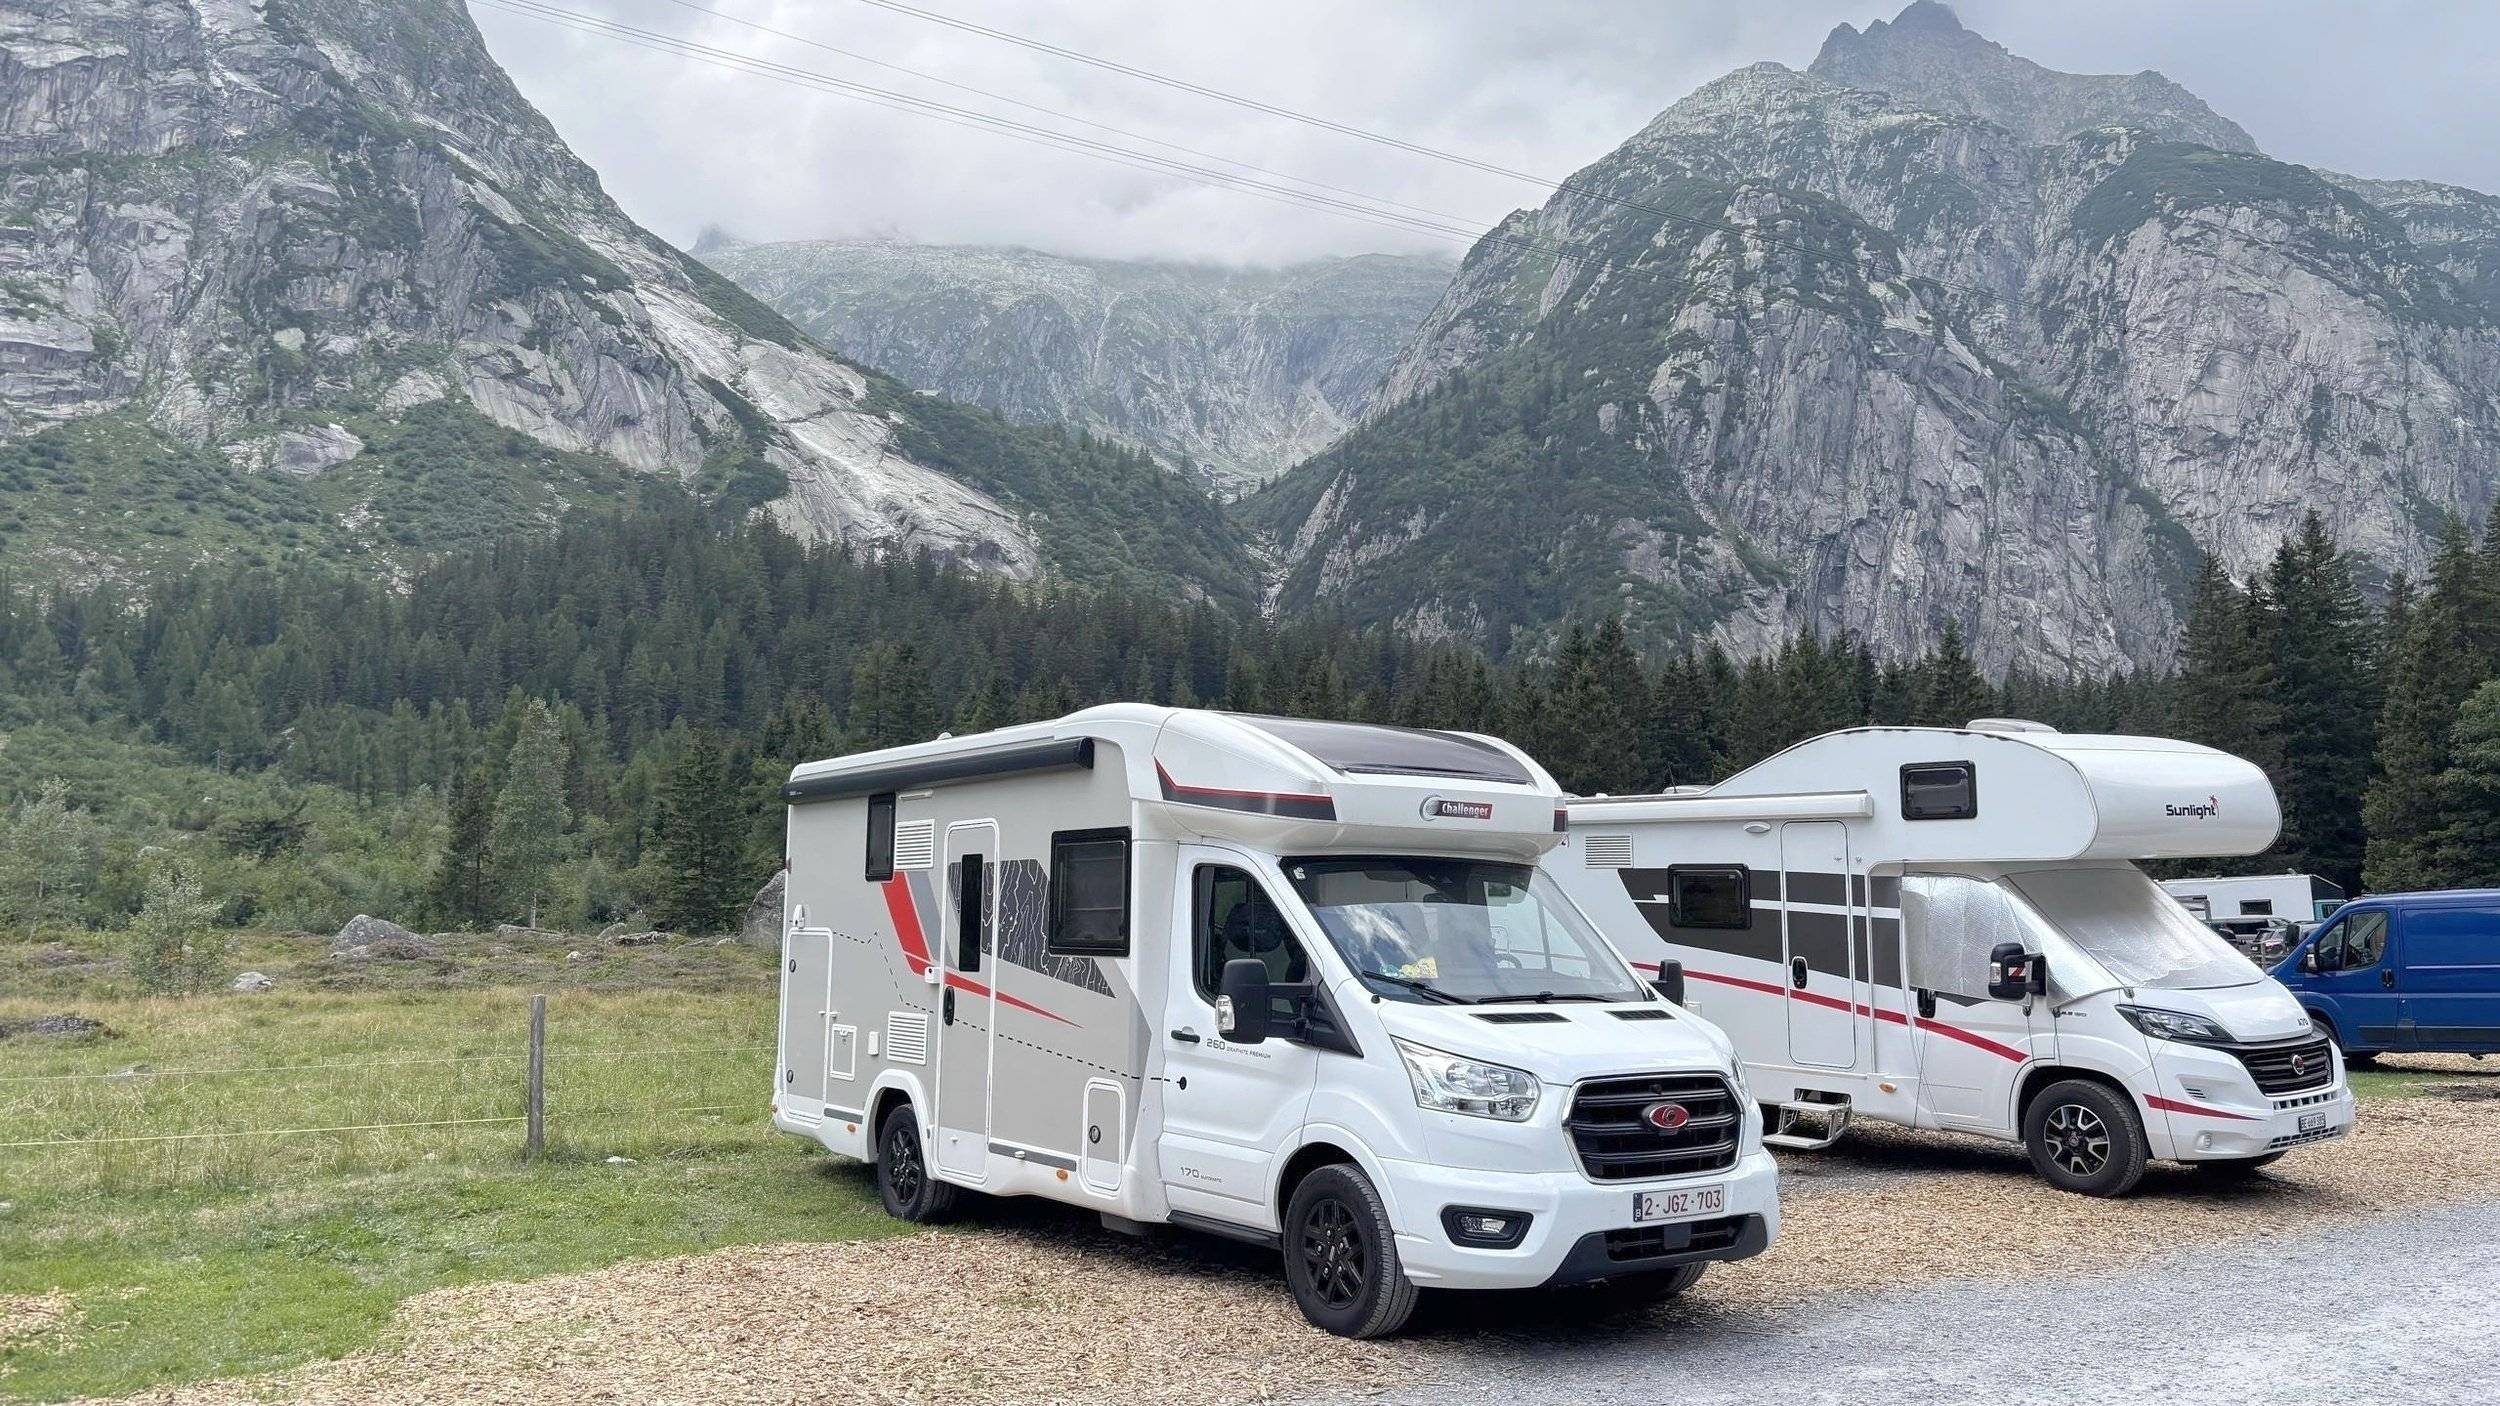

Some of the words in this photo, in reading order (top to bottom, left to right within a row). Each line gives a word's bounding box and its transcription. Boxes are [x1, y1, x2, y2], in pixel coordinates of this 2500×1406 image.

[1442, 802, 1489, 818] Challenger
[2165, 804, 2216, 820] Sunlight
[1206, 1038, 1226, 1050] 260
[1180, 1166, 1200, 1178] 170
